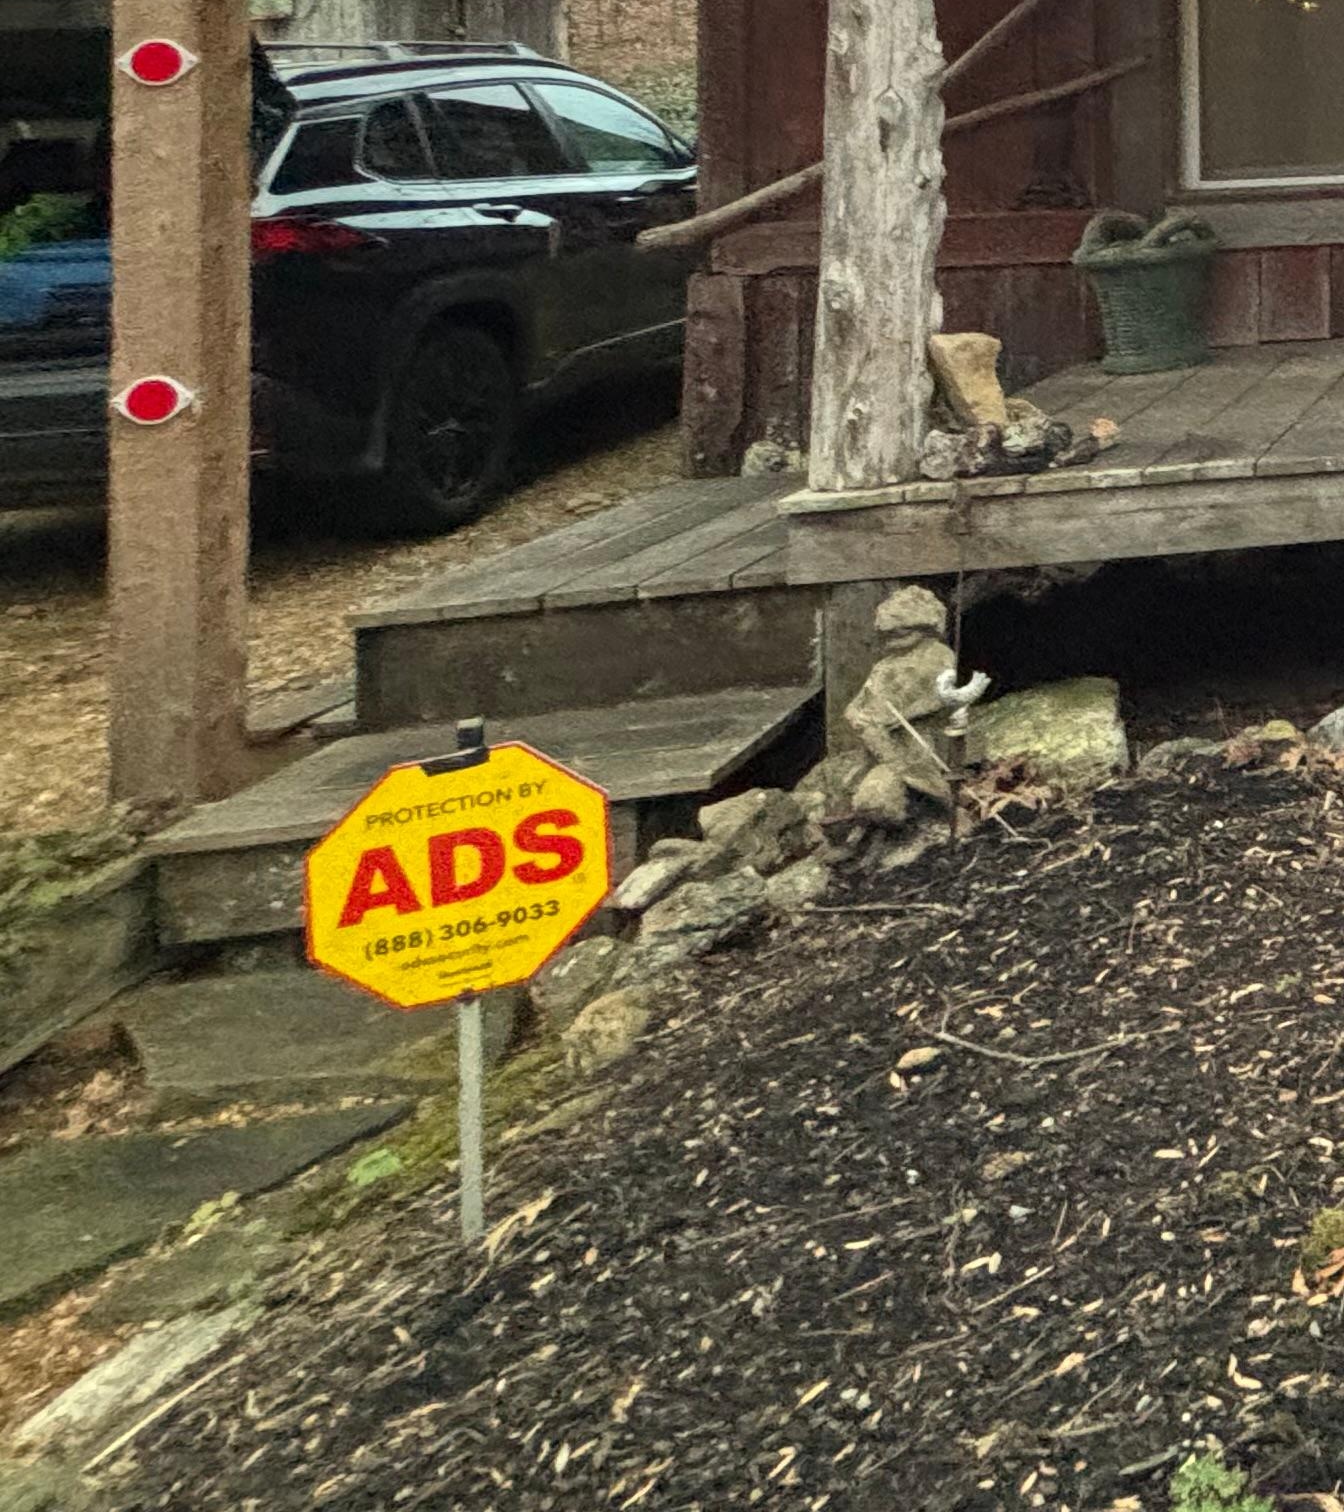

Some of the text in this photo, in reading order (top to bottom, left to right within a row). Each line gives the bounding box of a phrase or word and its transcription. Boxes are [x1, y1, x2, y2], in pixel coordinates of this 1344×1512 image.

[366, 780, 546, 829] PROTECTION BY
[337, 809, 585, 928] ADS
[364, 899, 561, 961] (888) 306-9033
